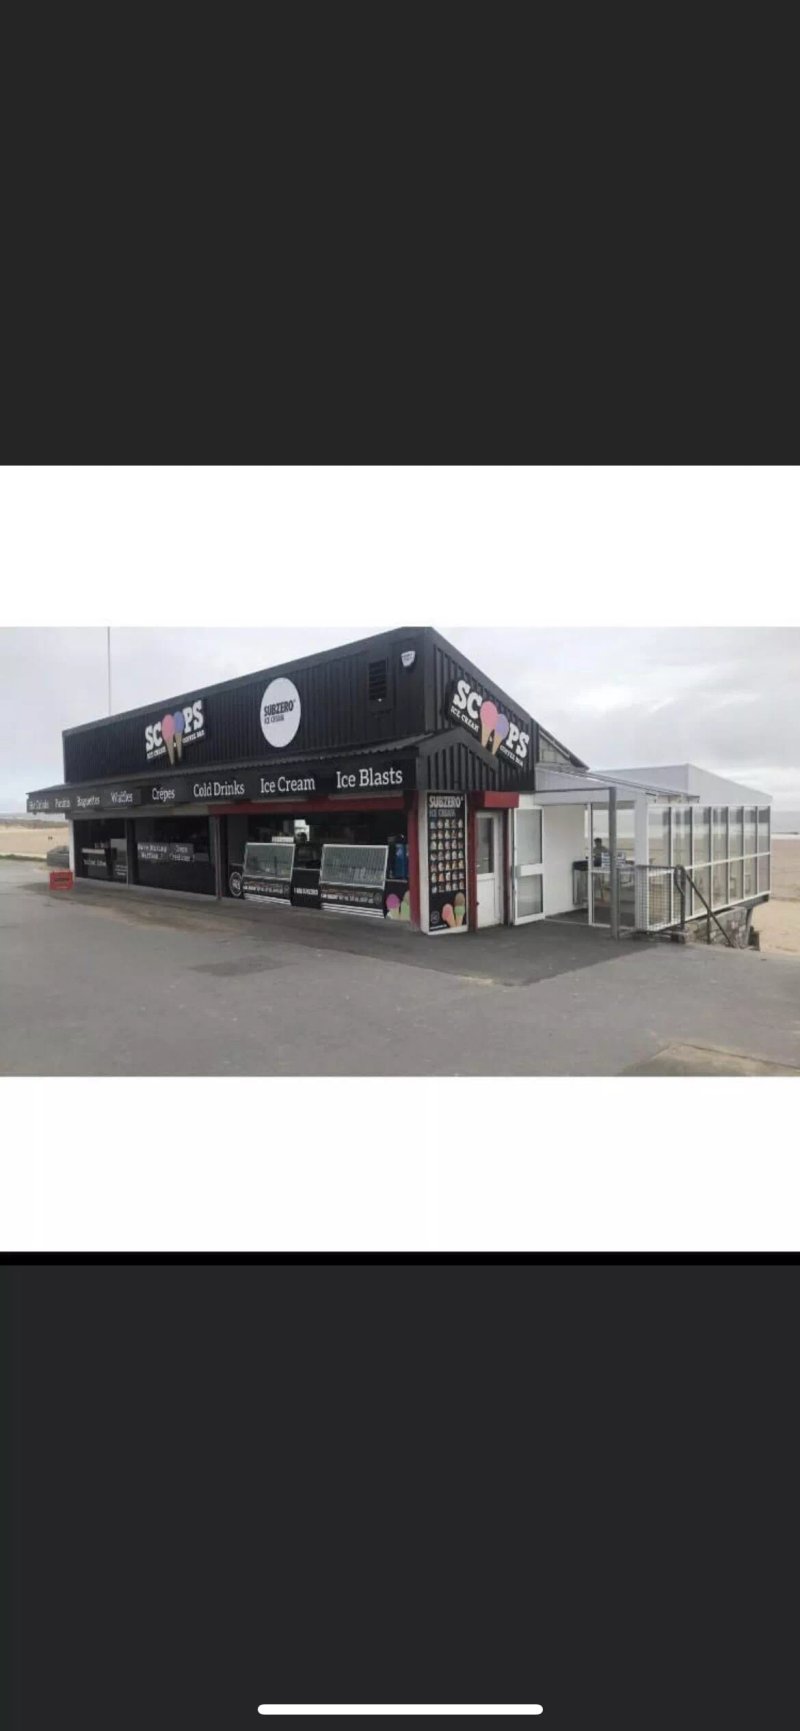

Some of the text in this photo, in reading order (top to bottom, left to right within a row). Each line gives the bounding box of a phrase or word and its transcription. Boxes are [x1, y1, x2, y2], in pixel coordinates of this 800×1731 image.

[264, 700, 294, 716] SUBZERO
[450, 705, 479, 733] ICE CREAM
[260, 776, 316, 794] Ice Cream
[336, 767, 403, 788] Ice Blasts
[111, 790, 133, 804] Waffles
[193, 780, 245, 798] Cold Drinks
[77, 795, 100, 808] Baguettes
[429, 796, 461, 808] SUBZERO
